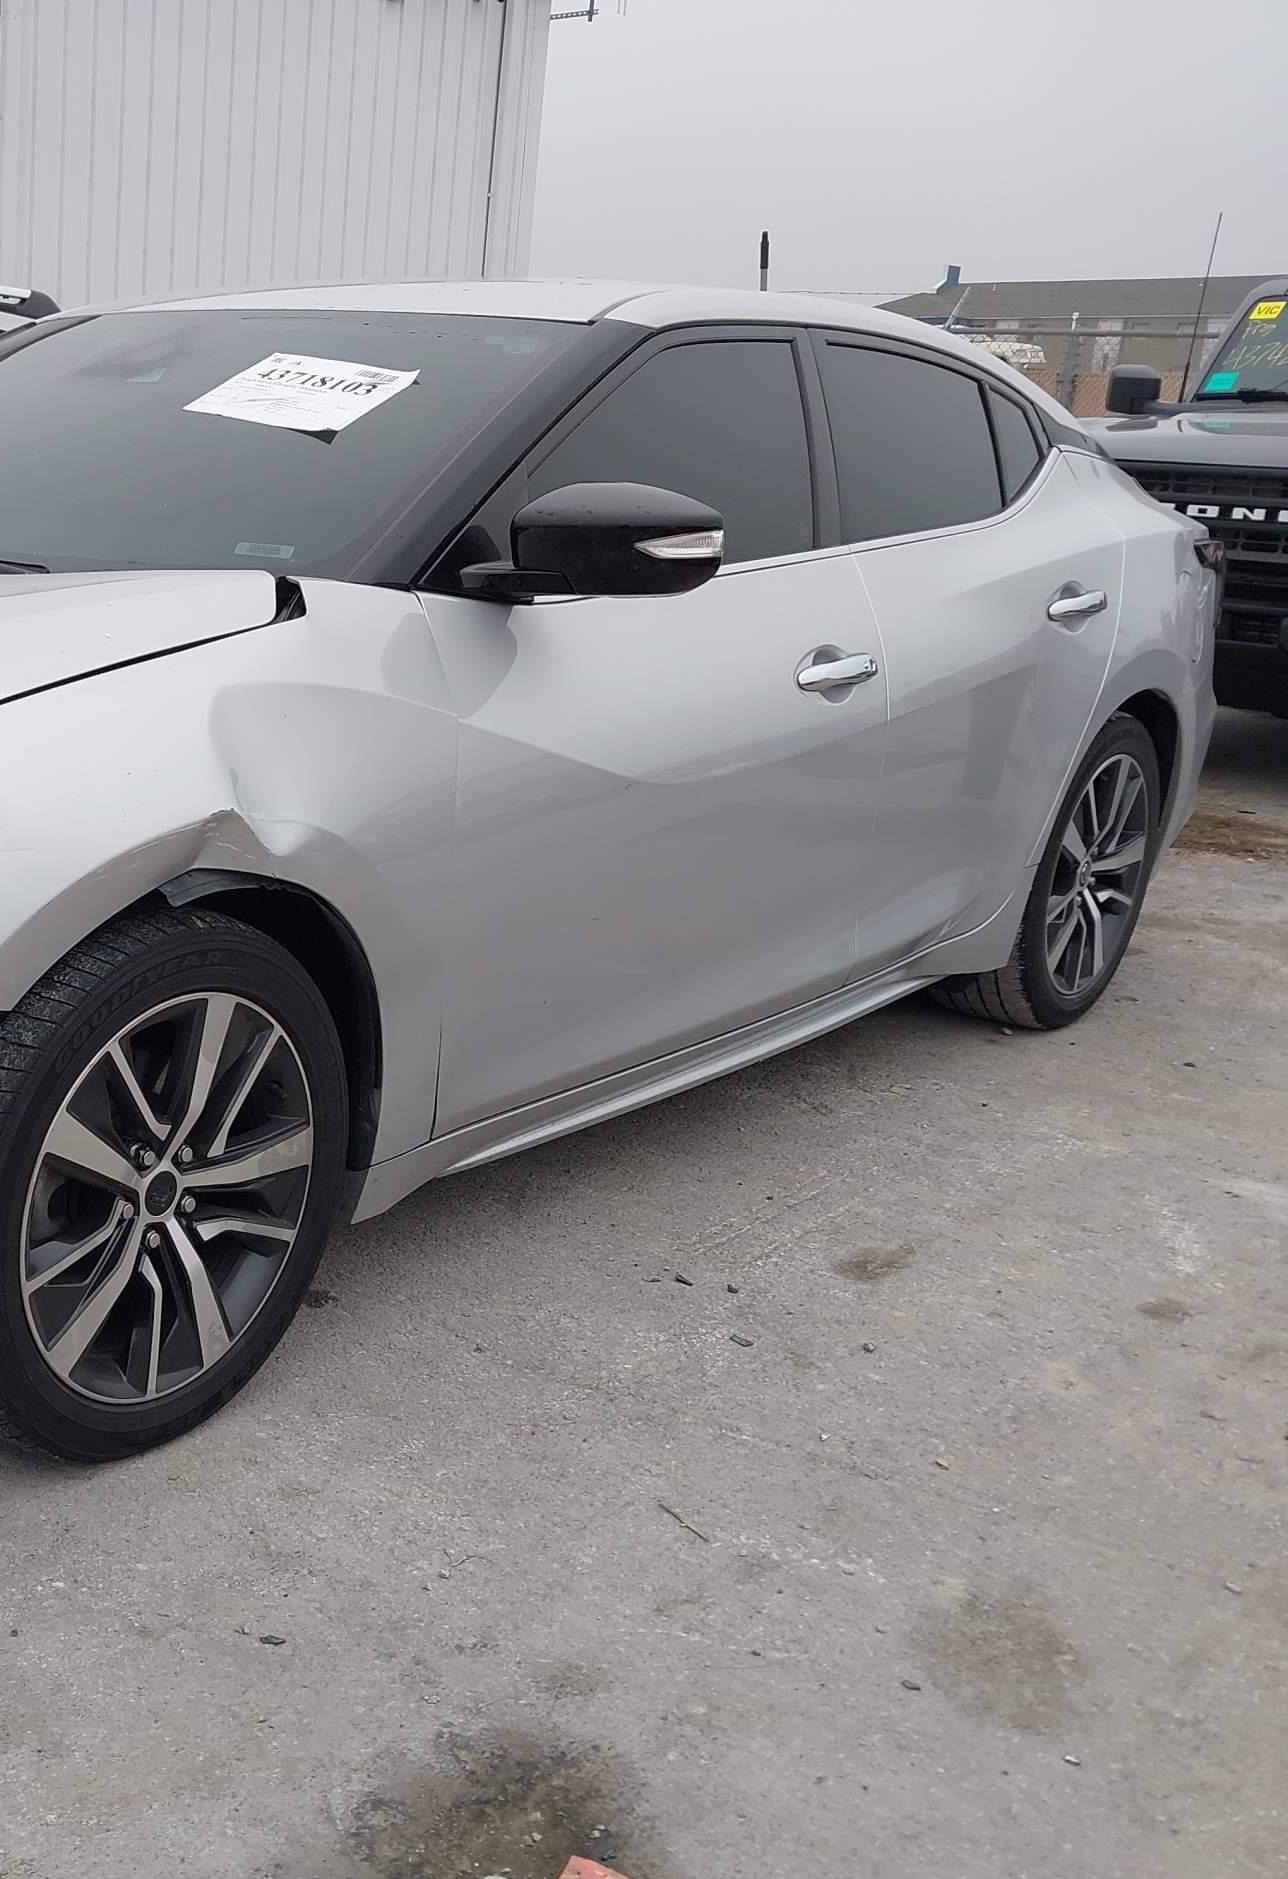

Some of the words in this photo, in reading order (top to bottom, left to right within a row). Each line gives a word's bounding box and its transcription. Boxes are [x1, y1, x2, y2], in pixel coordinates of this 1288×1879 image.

[1256, 305, 1281, 316] VIC
[257, 368, 378, 396] 43718103
[1159, 502, 1288, 523] ON
